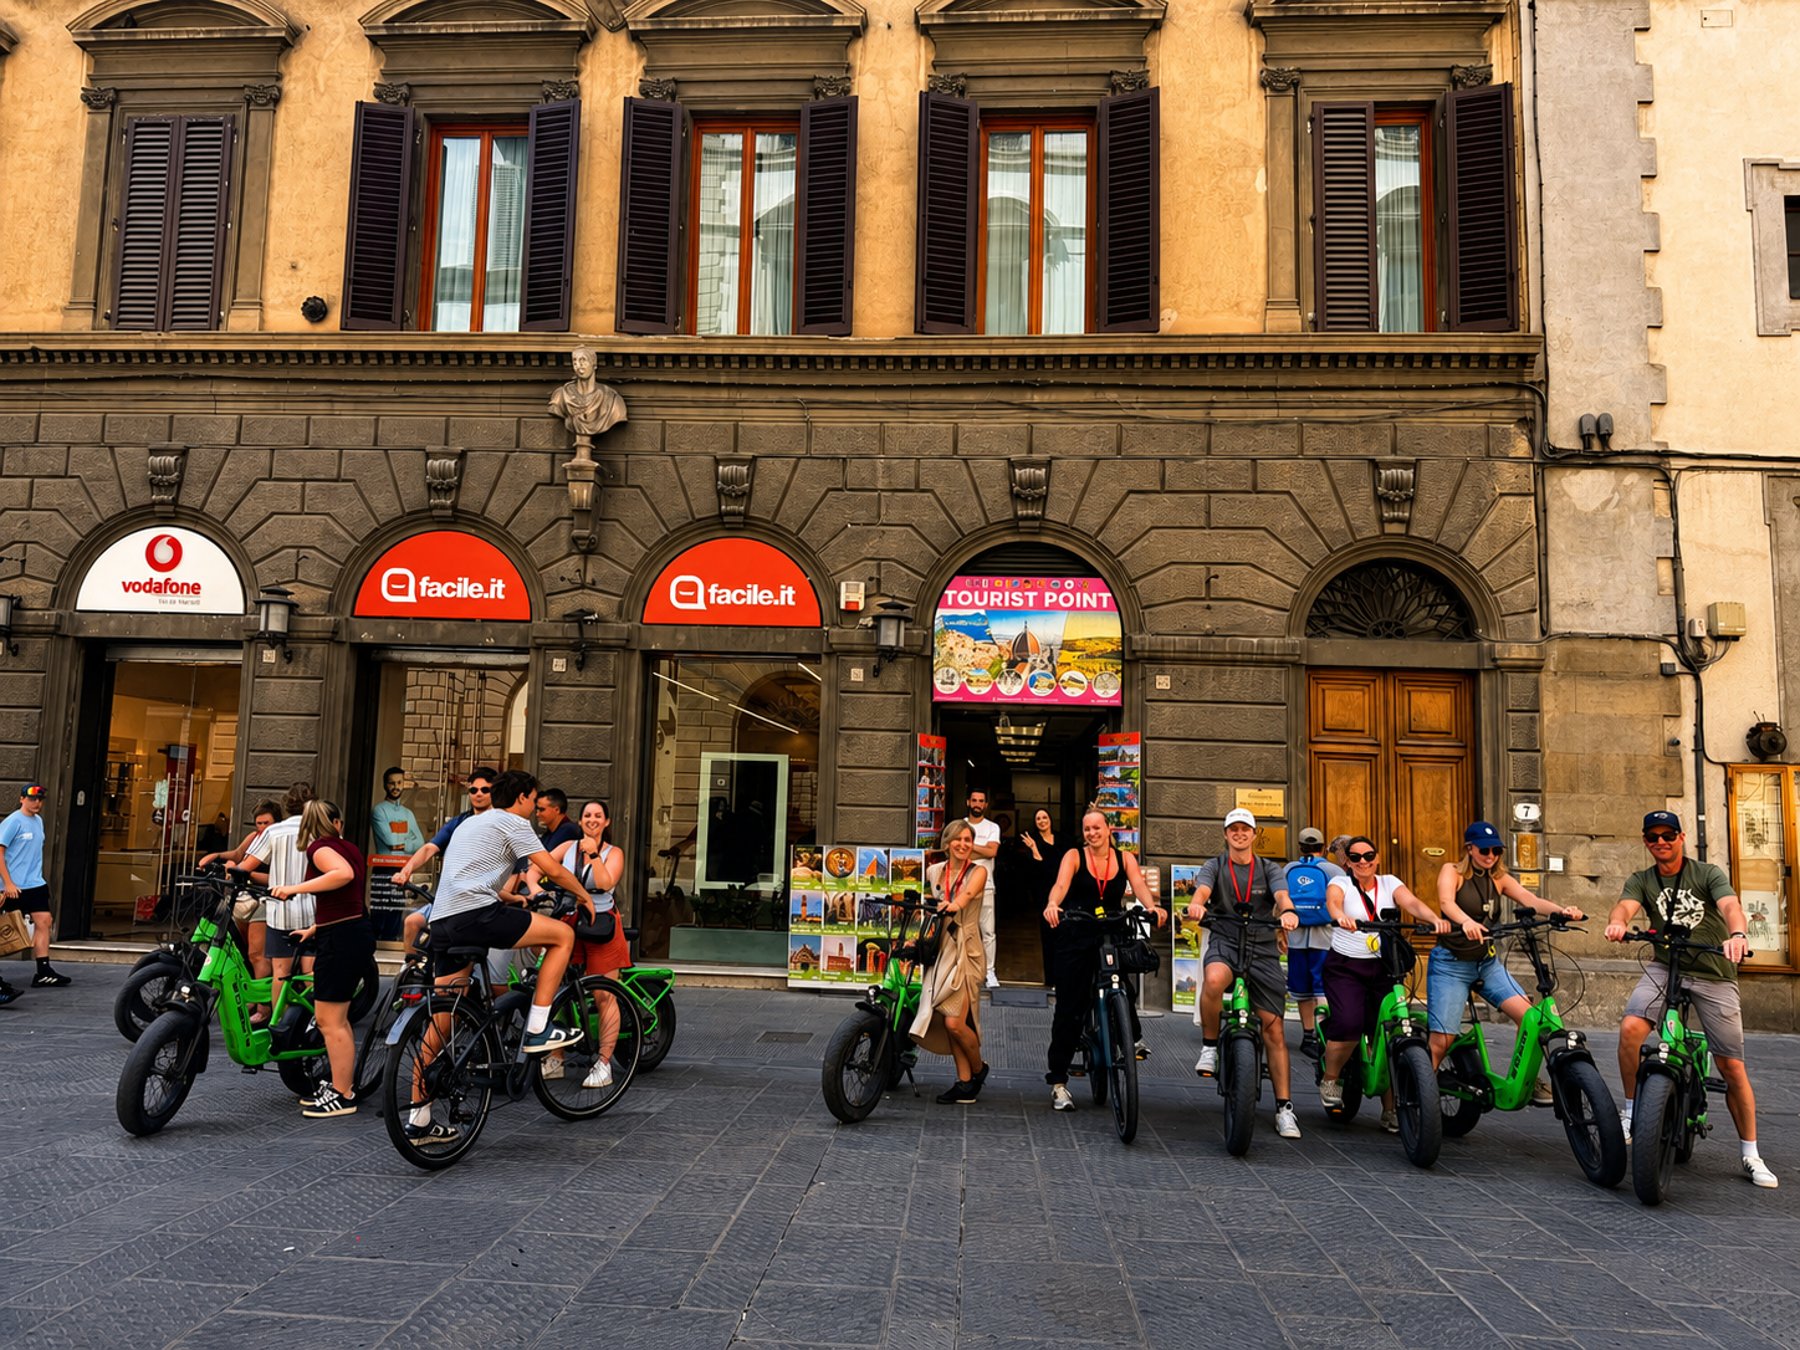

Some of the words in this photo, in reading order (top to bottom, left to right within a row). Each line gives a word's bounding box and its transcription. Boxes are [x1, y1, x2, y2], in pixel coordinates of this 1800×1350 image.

[121, 577, 202, 595] vodafone
[419, 575, 506, 600] facile.it
[707, 582, 796, 608] facile.it
[944, 590, 1038, 608] TOURIST
[1044, 591, 1112, 609] POINT
[1522, 805, 1531, 818] 7
